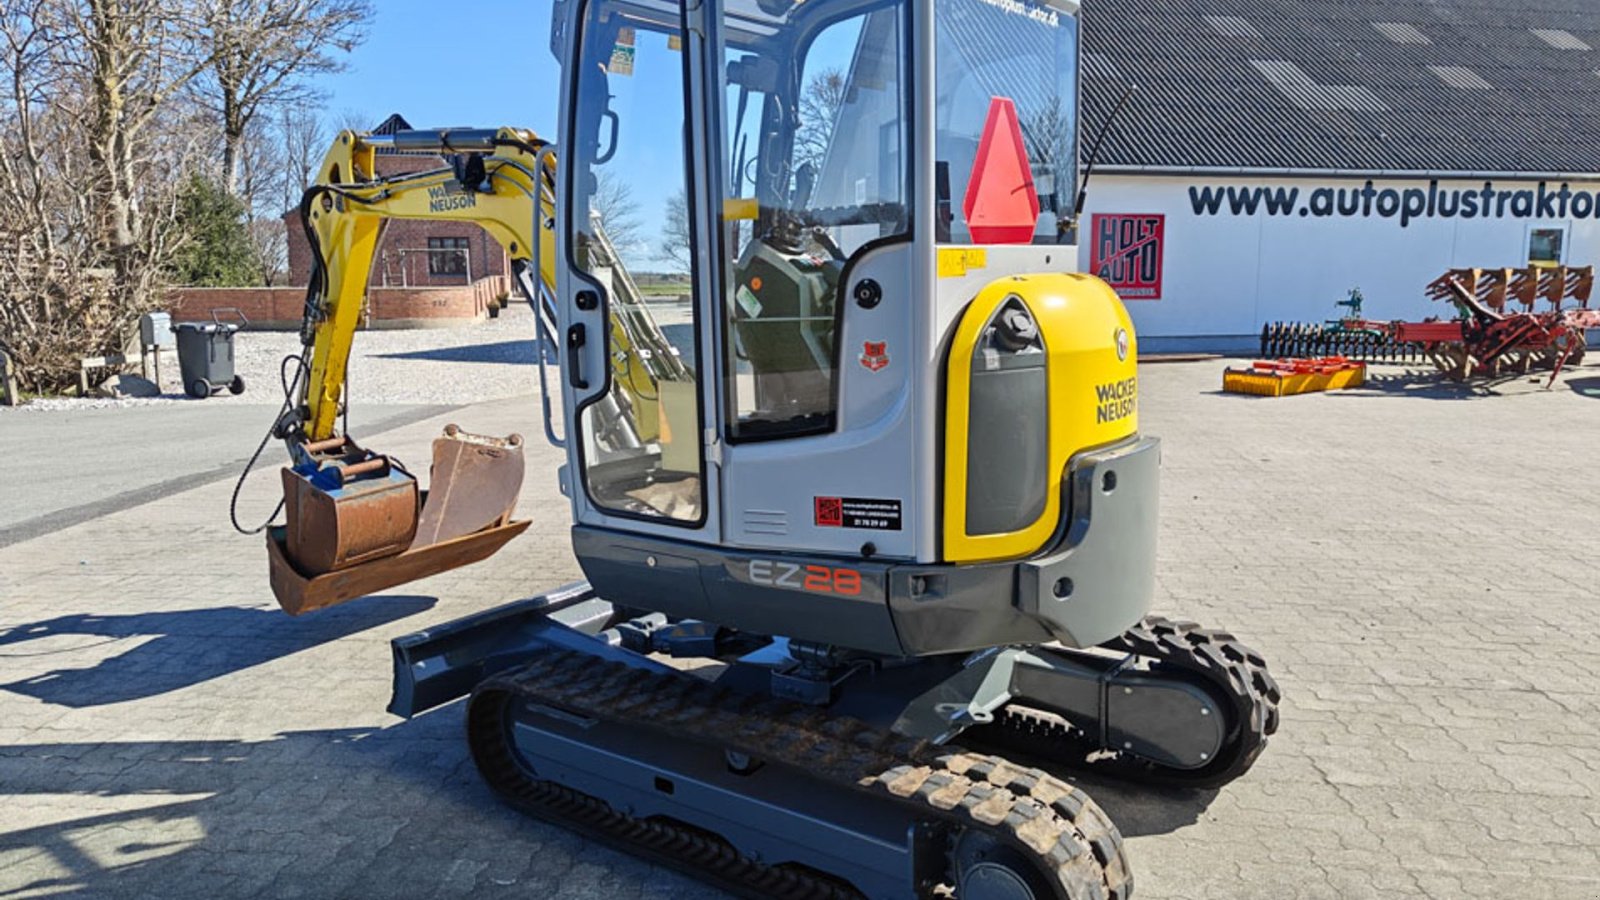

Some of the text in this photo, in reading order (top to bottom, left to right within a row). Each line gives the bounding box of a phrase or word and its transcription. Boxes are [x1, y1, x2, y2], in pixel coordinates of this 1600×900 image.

[429, 194, 476, 213] NEUSON
[1099, 218, 1158, 261] HOLT
[1099, 239, 1157, 282] AUTO
[749, 559, 861, 595] EZ28
